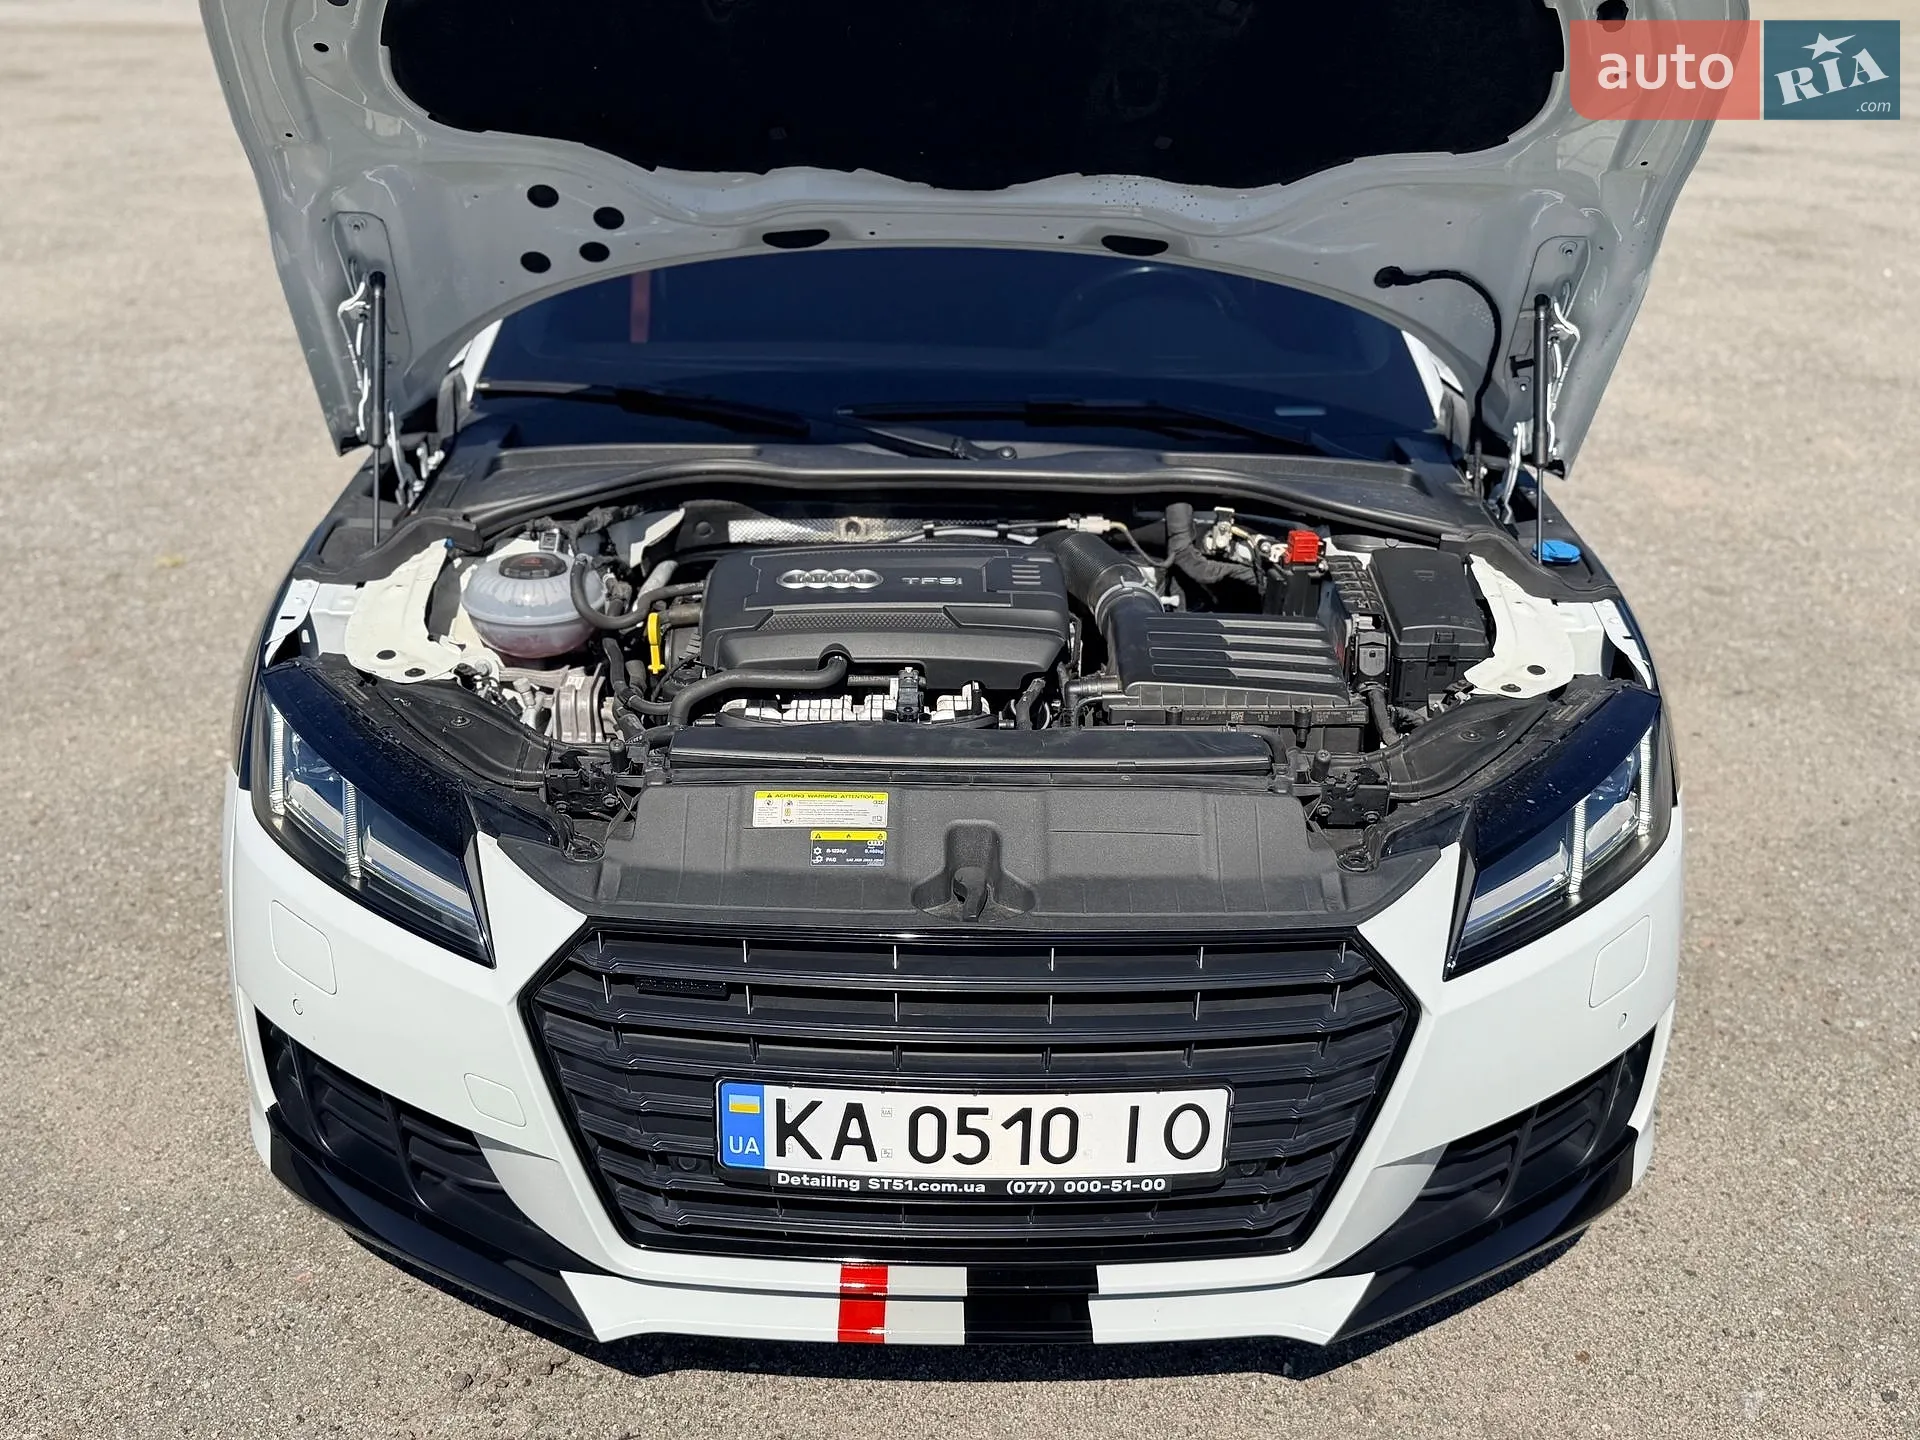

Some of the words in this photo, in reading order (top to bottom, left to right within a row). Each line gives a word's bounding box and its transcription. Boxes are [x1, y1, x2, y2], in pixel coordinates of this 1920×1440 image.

[902, 577, 963, 585] TFSI
[775, 1098, 878, 1163] KA
[908, 1105, 1080, 1166] 0510
[1126, 1102, 1211, 1164] IO
[729, 1135, 761, 1156] UA
[777, 1172, 861, 1191] Detailing
[867, 1178, 986, 1194] ST51.com.ua
[1006, 1180, 1056, 1195] (077)
[1063, 1178, 1166, 1193] 000-51-00
